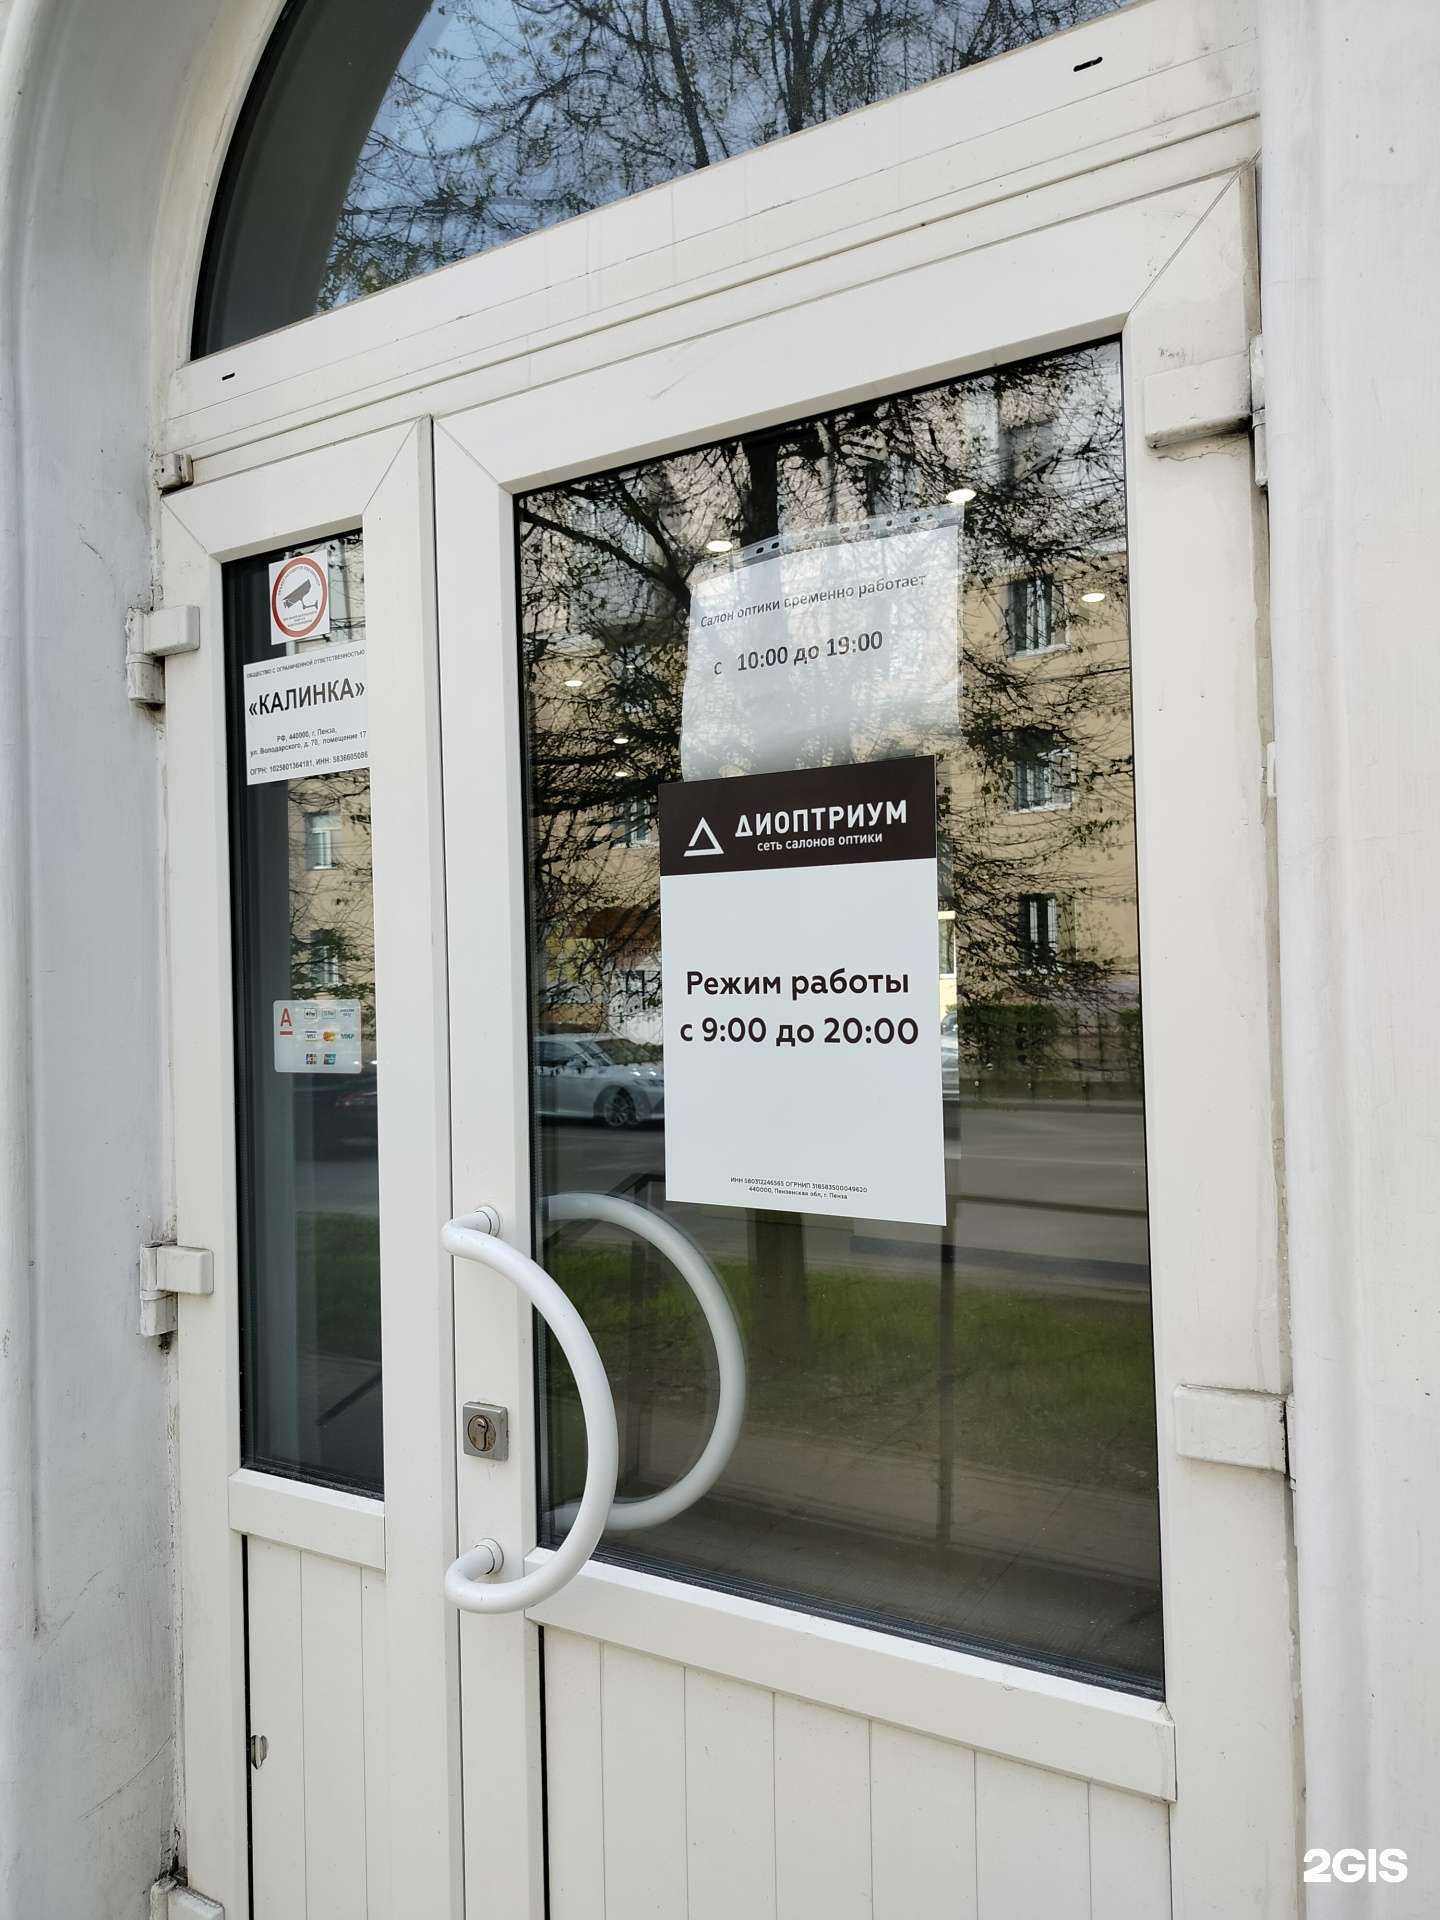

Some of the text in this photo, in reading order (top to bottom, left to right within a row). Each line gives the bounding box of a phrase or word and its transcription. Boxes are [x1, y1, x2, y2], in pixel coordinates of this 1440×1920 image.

[701, 575, 928, 628] Салон оптики временно работает
[276, 661, 313, 672] ОГРАНИЧЕННОЙ
[313, 649, 366, 665] ОТВЕТСТВЕННОСТЬЮ
[737, 646, 788, 671] 10:00
[793, 645, 820, 666] до
[826, 630, 883, 657] 19:00
[249, 678, 365, 716] «КАЛИНКА»
[276, 734, 288, 743] РФ,
[322, 734, 358, 745] помещение
[360, 730, 367, 738] 17
[249, 767, 268, 776] ОГРН:
[315, 758, 332, 766] ИНН:
[734, 800, 907, 838] ДИОПТРИУМ
[757, 832, 883, 852] сеть салонов оптики
[686, 968, 909, 1001] Режим работы
[680, 1016, 919, 1047] с 9:00 до 20:00
[748, 1185, 773, 1194] 440000,
[774, 1188, 809, 1197] Пензенская
[829, 1192, 848, 1200] Пенза
[786, 1181, 811, 1189] ОГРНИП
